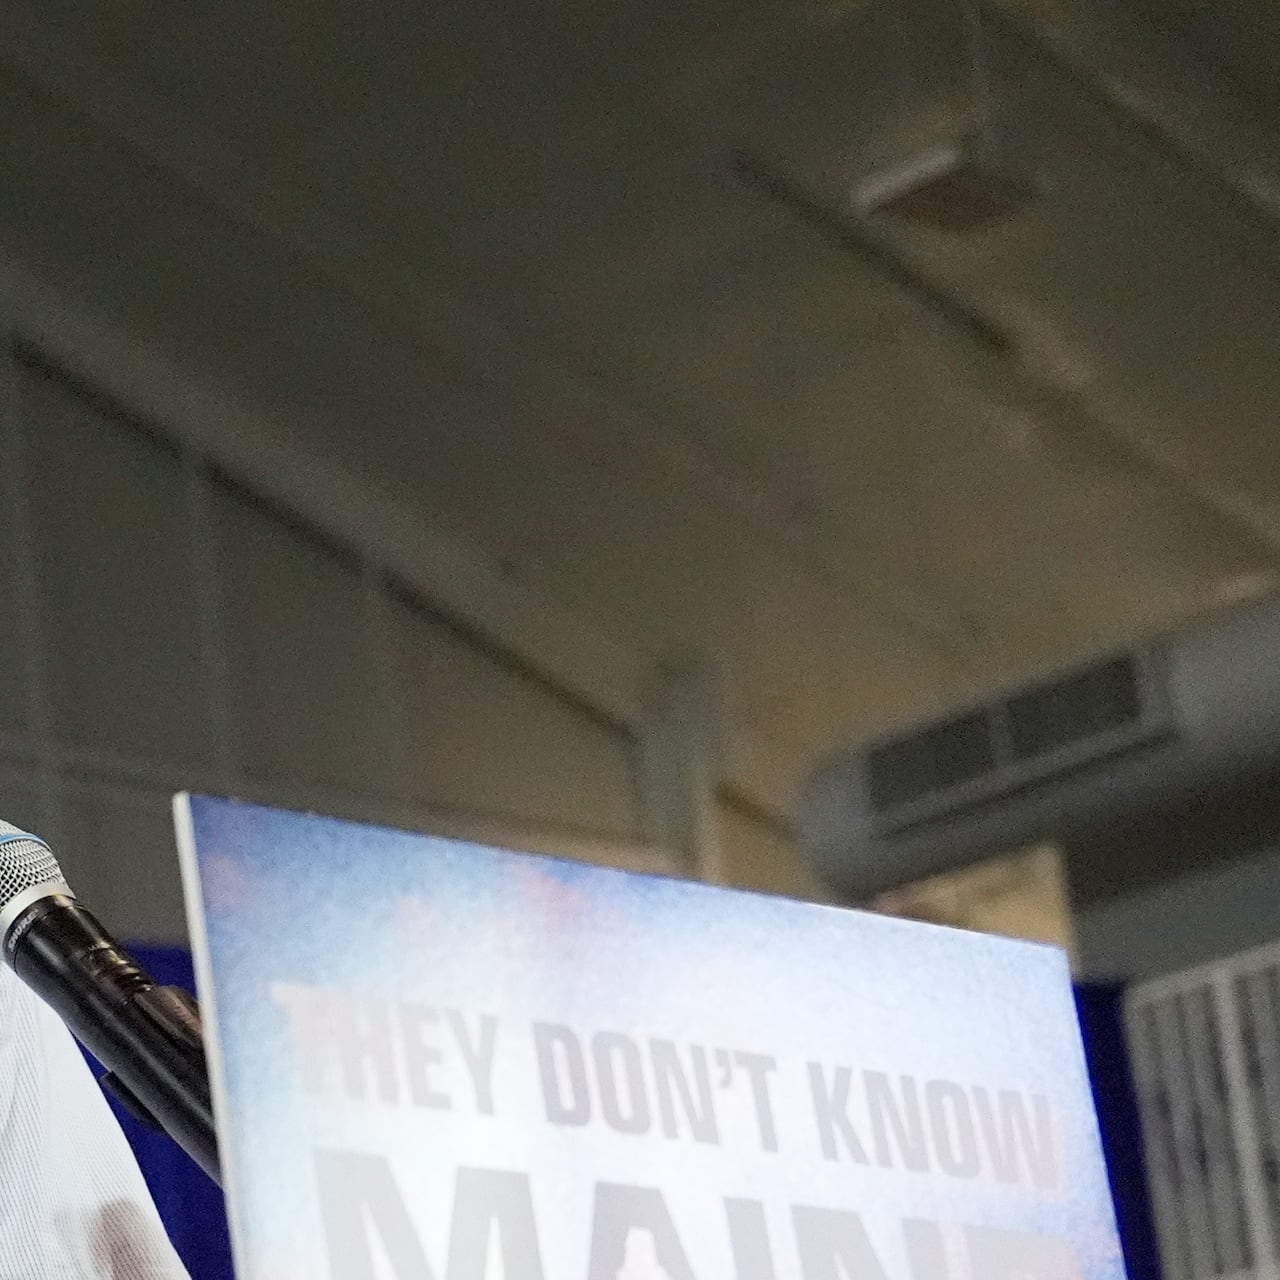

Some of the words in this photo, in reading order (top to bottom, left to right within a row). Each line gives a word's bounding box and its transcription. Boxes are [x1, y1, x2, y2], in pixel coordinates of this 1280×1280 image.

[272, 982, 498, 1117] THEY
[532, 1021, 779, 1154] DON'T
[807, 1060, 1061, 1191] KNOW
